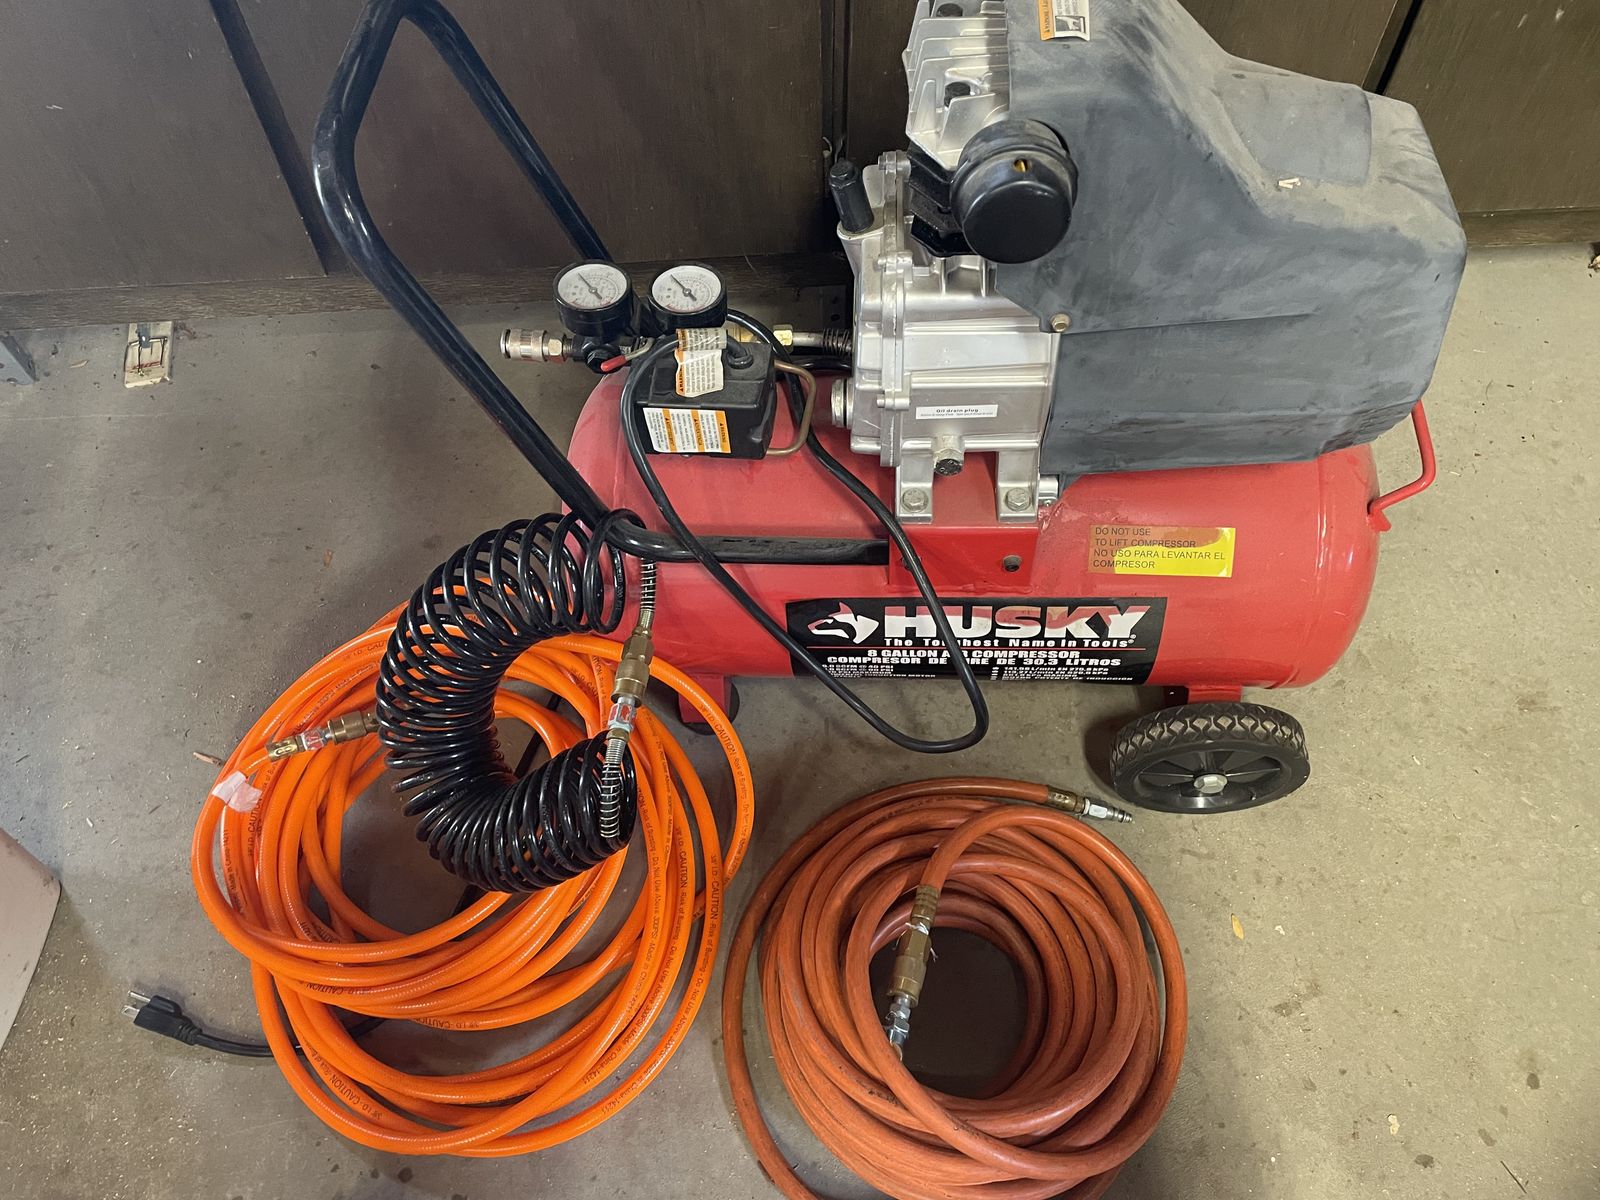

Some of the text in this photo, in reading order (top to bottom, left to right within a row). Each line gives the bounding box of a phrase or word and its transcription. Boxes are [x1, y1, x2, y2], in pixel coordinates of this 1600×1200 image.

[1095, 527, 1151, 536] DO NOT USE
[1109, 539, 1129, 547] LIFT
[1131, 540, 1197, 548] COMPRESSOR
[1093, 549, 1226, 560] NO USO PARA LEVANTAR EL
[1092, 560, 1156, 569] COMPRESOR
[884, 605, 1151, 638] HUSKY
[884, 638, 913, 647] The
[1009, 639, 1056, 648] Name
[867, 650, 878, 658] 8
[881, 650, 938, 658] GALLON
[972, 650, 1081, 659] COMPRESSOR
[827, 656, 921, 665] COMPRESOR
[928, 657, 948, 665] DE
[679, 851, 688, 888] CAUTION
[710, 880, 720, 920] CAUTION
[328, 1074, 361, 1106] CAUTION
